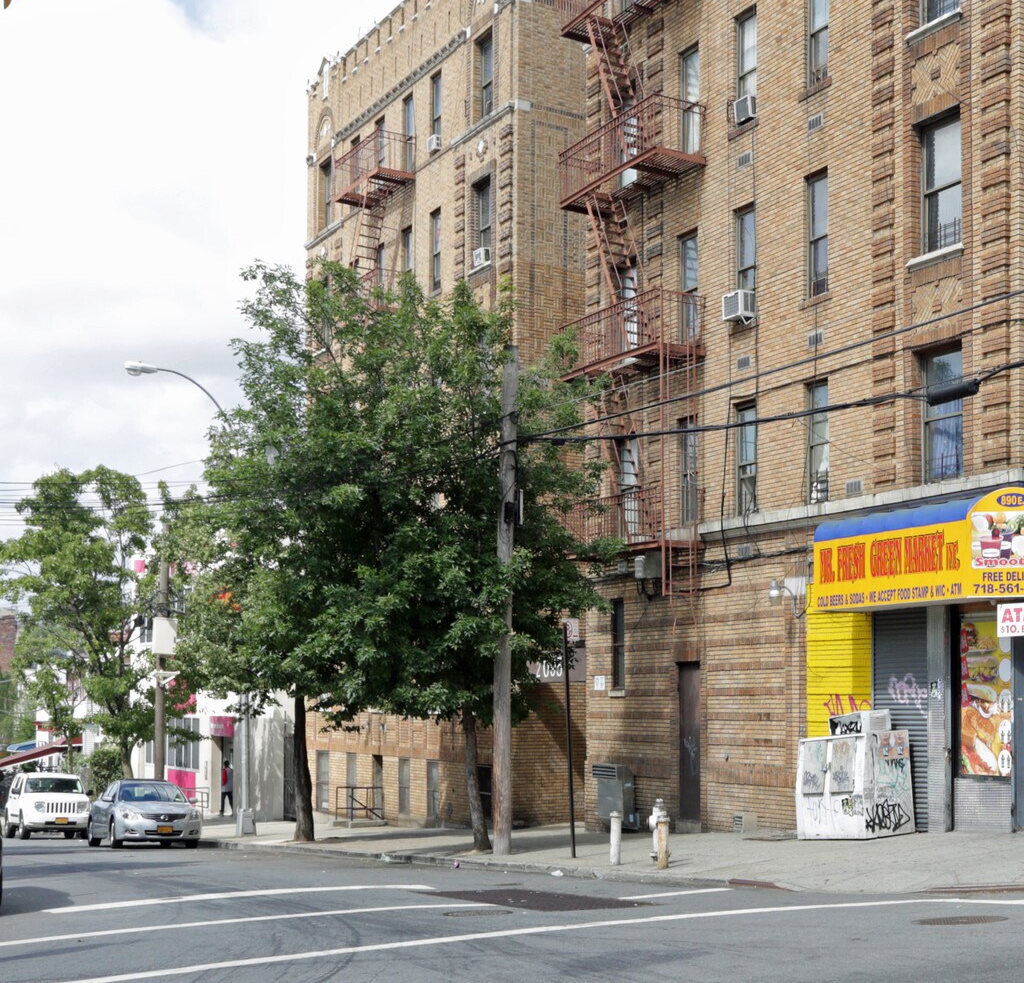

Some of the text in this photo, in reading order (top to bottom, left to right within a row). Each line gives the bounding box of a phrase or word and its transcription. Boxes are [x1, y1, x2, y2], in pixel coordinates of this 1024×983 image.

[1001, 495, 1017, 505] 890
[820, 548, 835, 584] MR.
[837, 542, 866, 583] FRESH
[870, 537, 902, 579] GREEN
[904, 529, 944, 574] MARKET
[982, 571, 1004, 582] FREE
[817, 596, 829, 608] COLD
[829, 594, 844, 606] BEERS
[849, 592, 865, 604] SODAS
[869, 591, 877, 603] WE
[877, 589, 896, 602] ACCEPT
[897, 587, 911, 600] FOOD
[912, 586, 929, 599] STAMP
[935, 584, 945, 597] WIC
[951, 583, 962, 595] ATM
[1001, 624, 1020, 634] $10.
